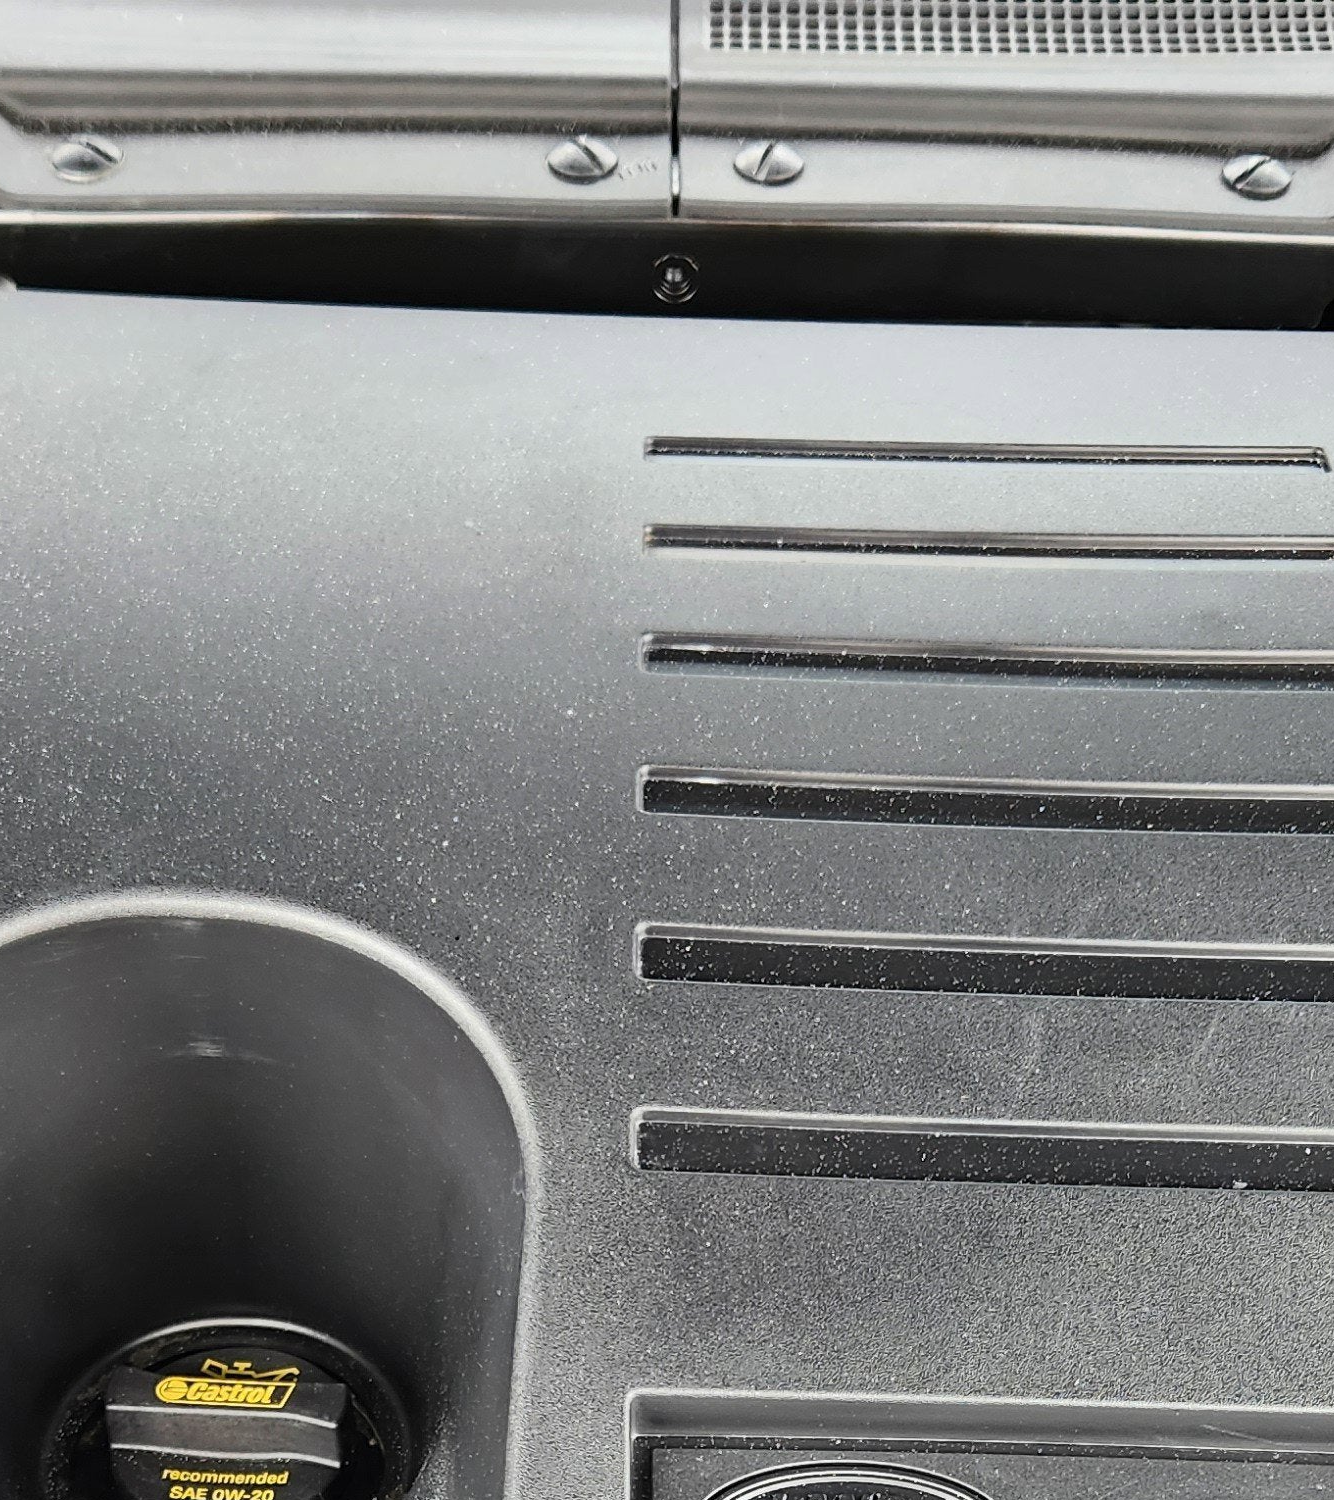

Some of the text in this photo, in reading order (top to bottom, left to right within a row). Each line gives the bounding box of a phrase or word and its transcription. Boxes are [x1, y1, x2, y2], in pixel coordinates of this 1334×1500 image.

[188, 1382, 274, 1405] Castrol
[162, 1468, 289, 1485] recommended
[168, 1485, 207, 1500] SAE
